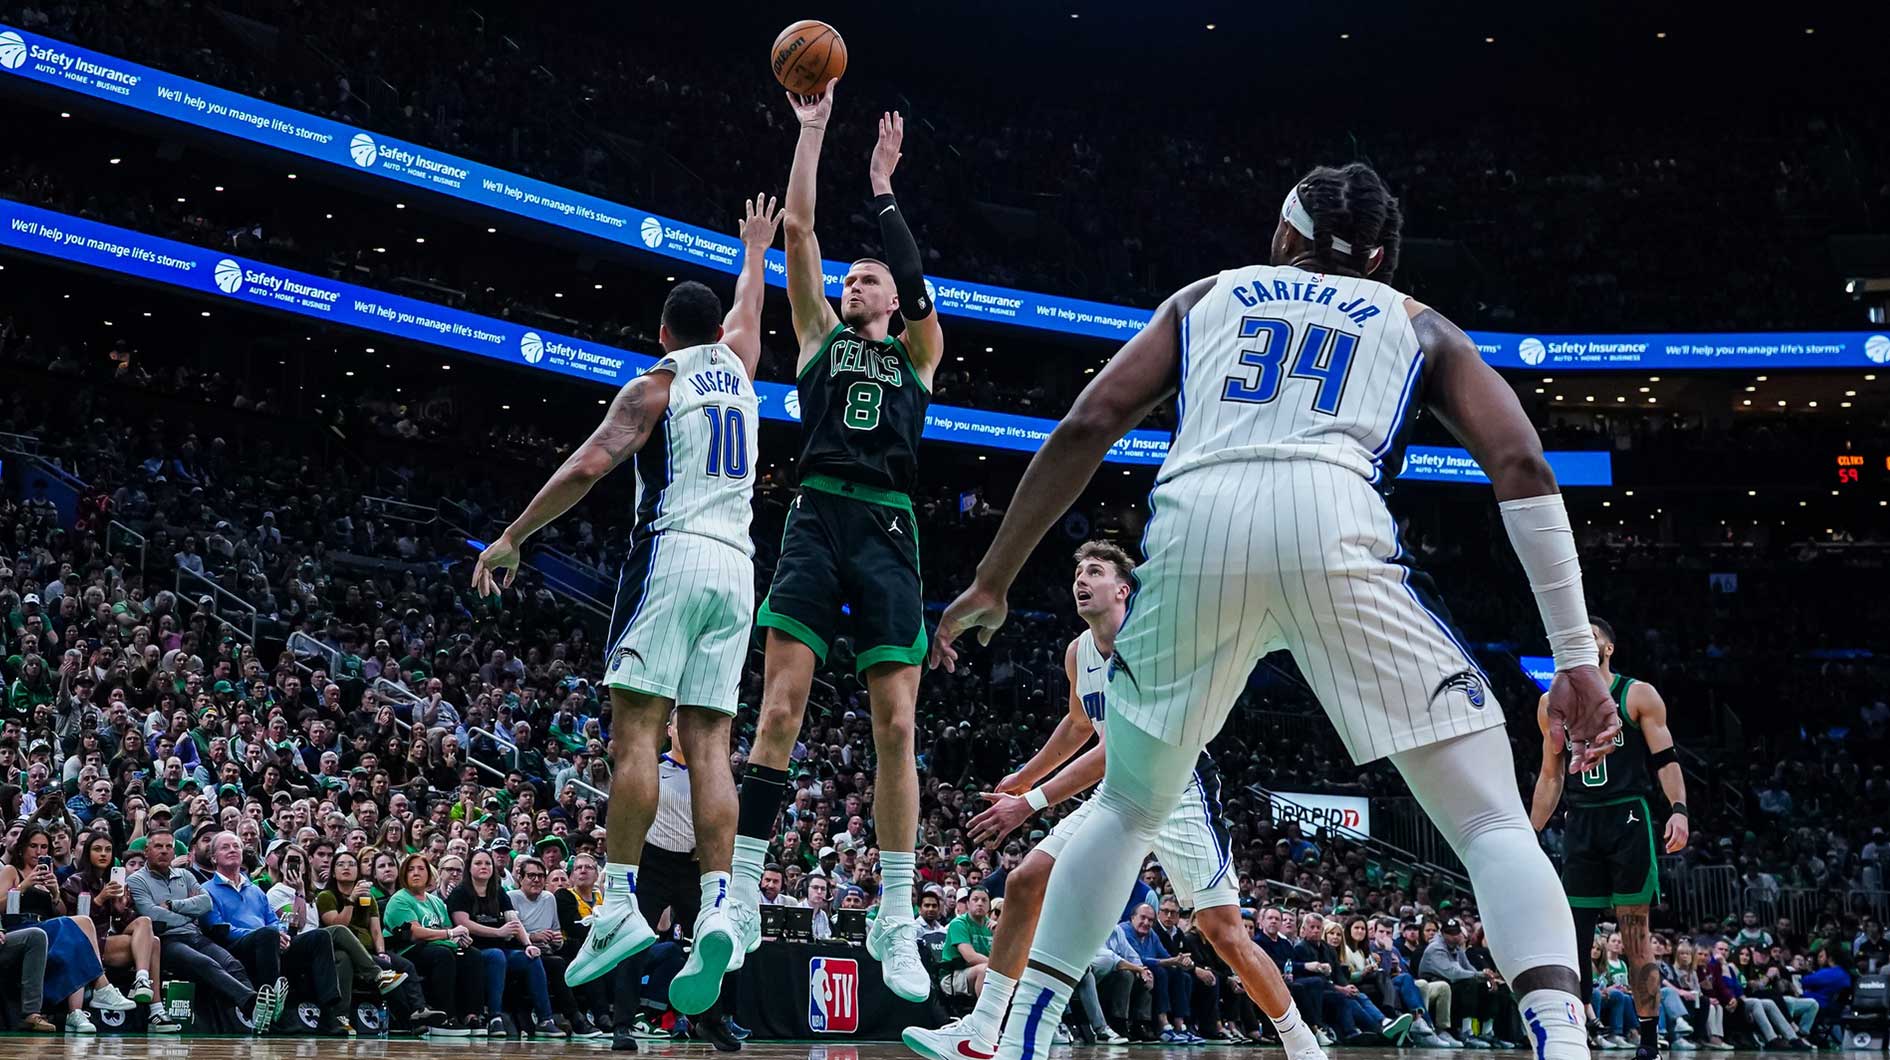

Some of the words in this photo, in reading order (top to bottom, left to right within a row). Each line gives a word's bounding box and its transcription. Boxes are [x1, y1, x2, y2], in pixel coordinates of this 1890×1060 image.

[30, 45, 74, 70] Safety
[75, 57, 137, 86] Insurance
[35, 63, 56, 74] AUTO
[65, 72, 88, 84] HOME
[96, 80, 130, 95] BUSINESS
[158, 86, 182, 102] We'll
[184, 94, 206, 111] help
[207, 103, 227, 115] you
[228, 109, 270, 128] manage
[271, 119, 294, 134] life's
[295, 128, 329, 144] storms
[378, 145, 415, 167] Safety
[415, 155, 467, 179] Insurance
[383, 161, 400, 171] AUTO
[407, 168, 426, 179] HOME
[433, 175, 460, 188] BUSINESS
[483, 179, 503, 193] We'll
[504, 185, 523, 200] help
[523, 193, 540, 204] you
[541, 198, 575, 215] manage
[576, 205, 595, 219] life's
[595, 213, 623, 227] storms
[12, 218, 38, 234] We'll
[39, 225, 63, 242] help
[63, 233, 85, 245] you
[87, 239, 130, 257] manage
[131, 247, 156, 262] life's
[157, 255, 190, 271] storms
[664, 227, 694, 247] Safety
[695, 235, 738, 257] Insurance
[668, 242, 683, 251] AUTO
[688, 248, 704, 257] HOME
[709, 254, 732, 265] BUSINESS
[769, 261, 785, 274] help
[244, 270, 283, 291] Safety
[283, 278, 337, 302] Insurance
[249, 287, 267, 296] AUTO
[275, 293, 295, 303] HOME
[302, 299, 331, 311] BUSINESS
[938, 286, 971, 303] Safety
[972, 291, 1021, 308] Insurance
[942, 300, 959, 308] AUTO
[989, 307, 1015, 316] BUSINESS
[1037, 305, 1057, 316] We'll
[1058, 308, 1076, 321] help
[1076, 313, 1093, 322] you
[1094, 316, 1127, 329] manage
[1233, 280, 1337, 307] CARTER
[1337, 298, 1381, 328] JR.
[354, 301, 376, 314] We'll
[377, 305, 396, 321] help
[397, 313, 415, 323] you
[415, 317, 452, 333] manage
[452, 323, 472, 337] life's
[473, 330, 502, 344] storms
[545, 342, 577, 360] Safety
[577, 348, 622, 369] Insurance
[1548, 342, 1587, 356] Safety
[1589, 342, 1646, 353] Insurance
[1666, 346, 1690, 355] We'll
[1692, 346, 1714, 356] help
[1716, 347, 1735, 356] you
[1736, 346, 1779, 356] manage
[1780, 344, 1804, 354] life's
[1806, 345, 1840, 353] storms
[549, 357, 565, 365] AUTO
[570, 362, 587, 371] HOME
[593, 367, 617, 377] BUSINESS
[1220, 316, 1361, 417] 34
[689, 371, 740, 396] JOSEPH
[843, 381, 883, 430] 8
[703, 405, 748, 479] 10
[934, 417, 953, 430] help
[953, 422, 970, 431] you
[971, 424, 1006, 436] manage
[1006, 426, 1026, 437] life's
[1027, 430, 1050, 440] storm
[1133, 437, 1169, 449] Insura
[1410, 454, 1445, 468] Safety
[1447, 456, 1480, 468] Insura
[1839, 468, 1858, 484] 59
[832, 973, 854, 1018] TV
